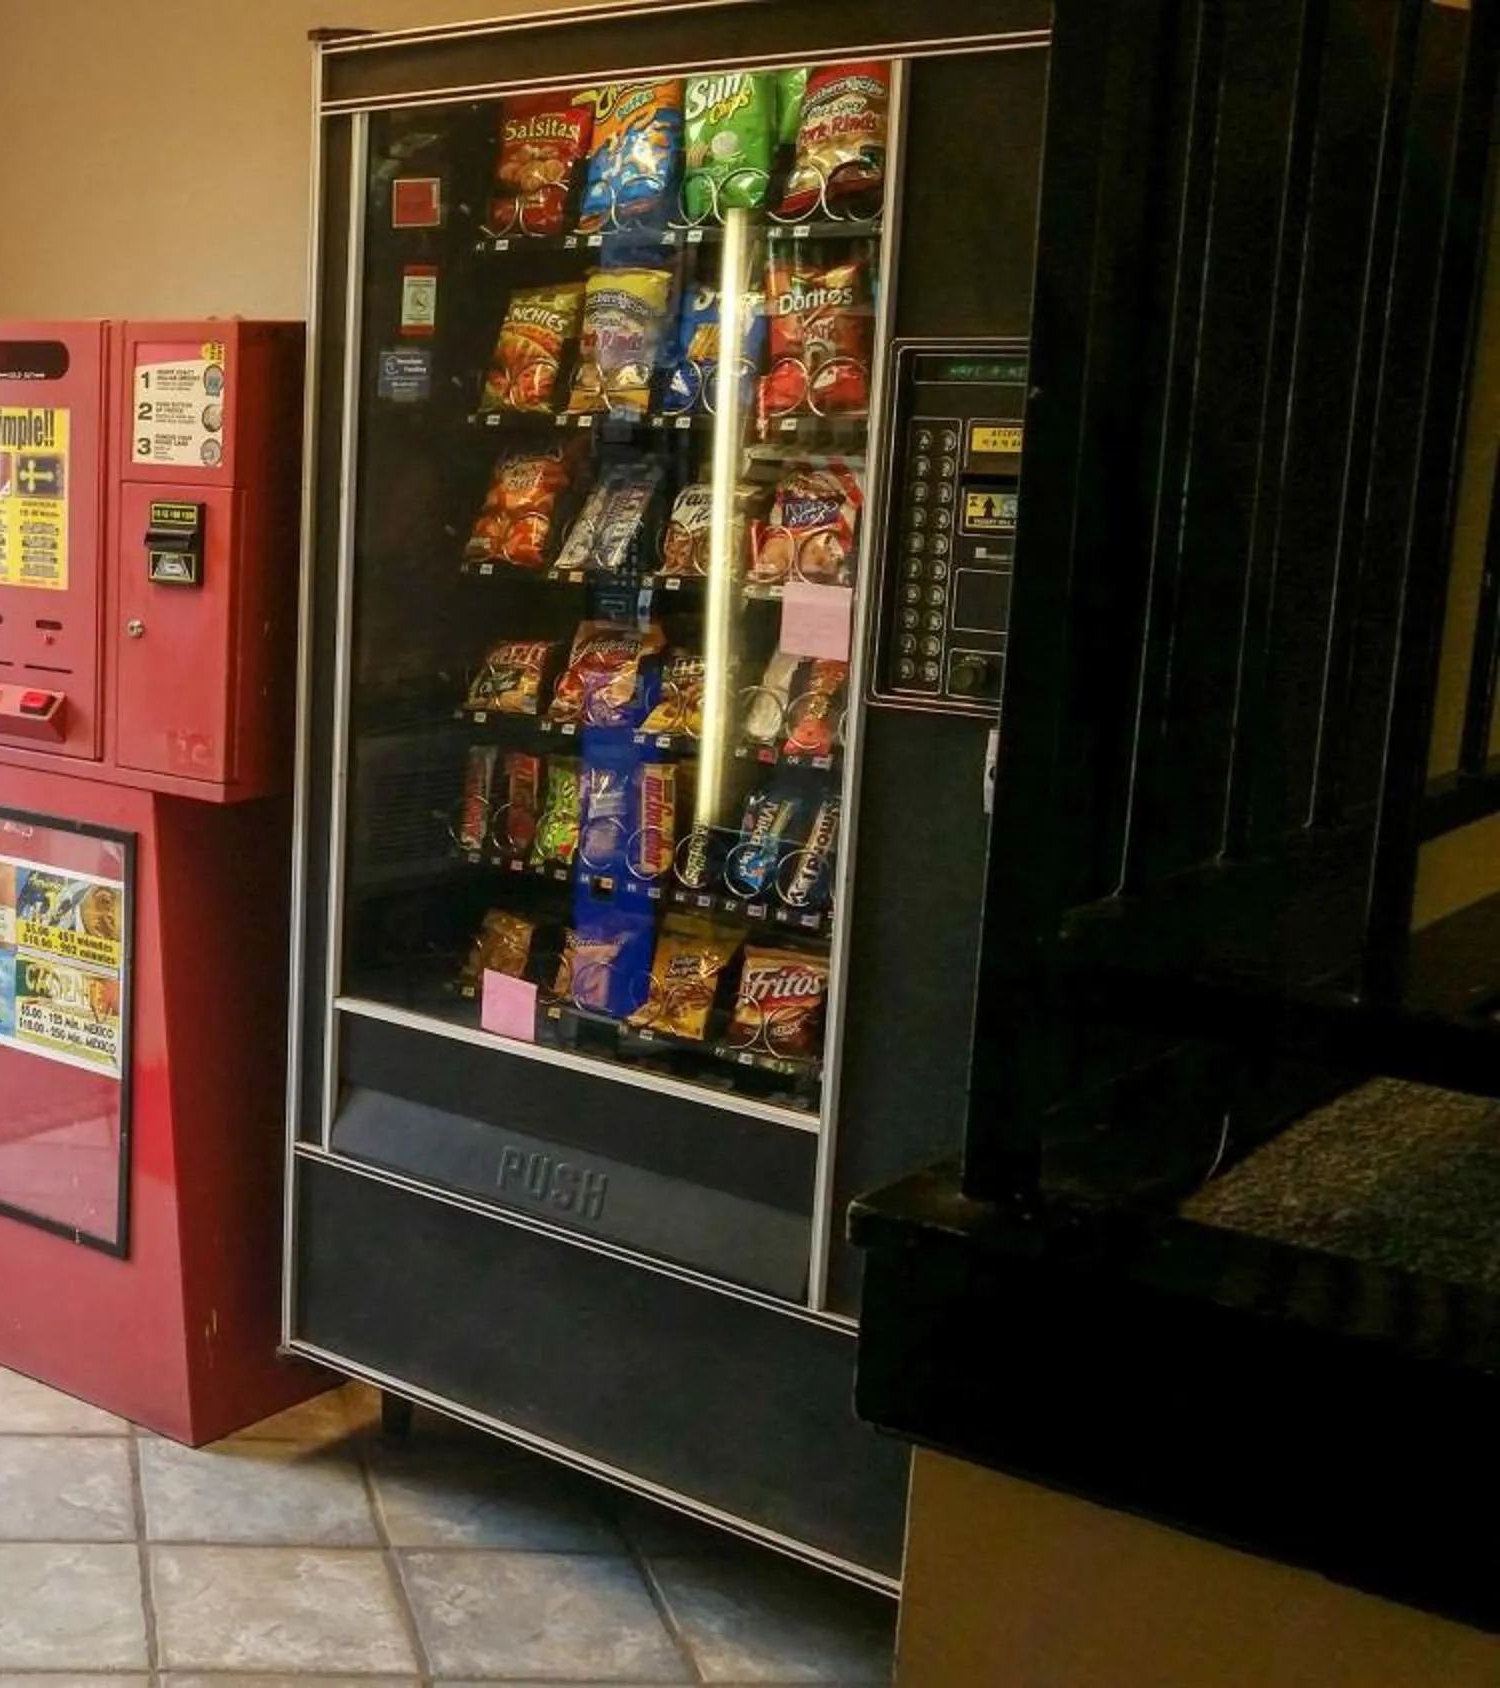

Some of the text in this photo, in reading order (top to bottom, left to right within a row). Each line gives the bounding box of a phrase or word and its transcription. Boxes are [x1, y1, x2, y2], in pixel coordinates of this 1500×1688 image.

[686, 73, 742, 120] Sun
[706, 89, 751, 125] Chips
[505, 114, 581, 141] Salsitas
[779, 286, 854, 315] Doritos
[141, 371, 150, 389] 1
[137, 402, 153, 421] 2
[137, 437, 152, 456] 3
[750, 966, 826, 1000] Fritos
[497, 1145, 609, 1220] PUSH
